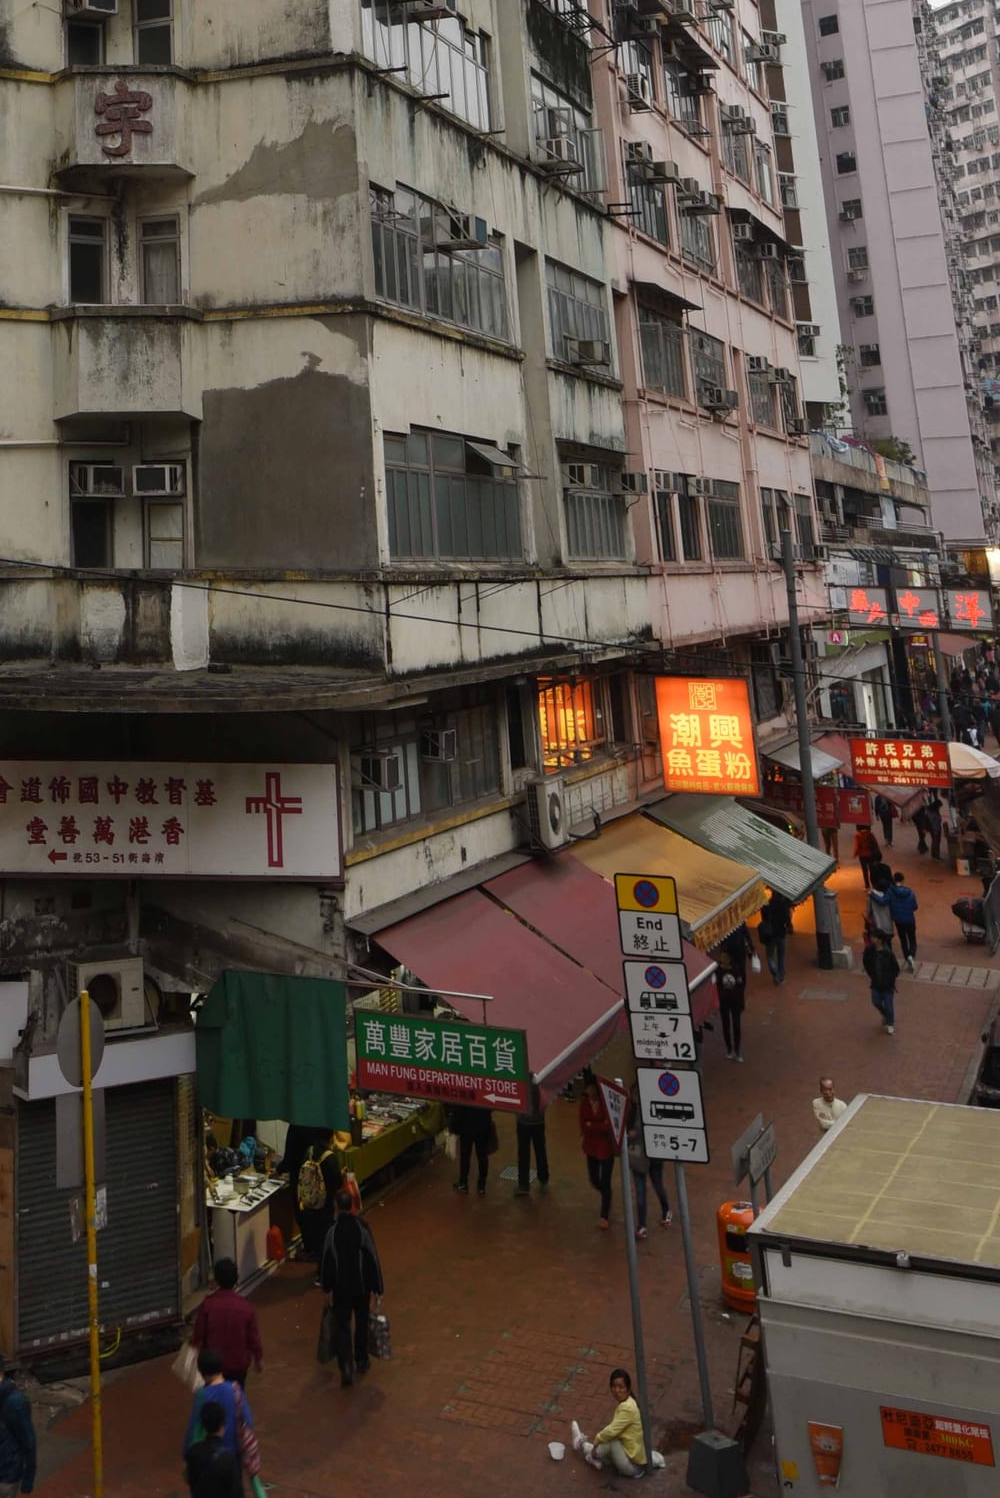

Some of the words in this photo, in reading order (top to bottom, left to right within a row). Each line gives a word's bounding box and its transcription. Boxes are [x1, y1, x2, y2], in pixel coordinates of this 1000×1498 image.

[94, 81, 154, 157] 宇
[669, 713, 743, 748] 潮興
[865, 742, 934, 758] 許氏兄弟
[666, 749, 752, 780] 魚蛋粉
[636, 917, 664, 931] End
[632, 933, 671, 953] 終止
[668, 1017, 680, 1033] 7
[363, 1019, 517, 1075] 萬豐家居百貨
[636, 1038, 669, 1048] midnight
[673, 1042, 692, 1059] 12
[366, 1061, 389, 1077] MAN
[390, 1065, 417, 1082] FUNG
[418, 1068, 483, 1091] DEPARTMENT
[485, 1078, 518, 1094] STORE
[669, 1136, 697, 1152] 5-7
